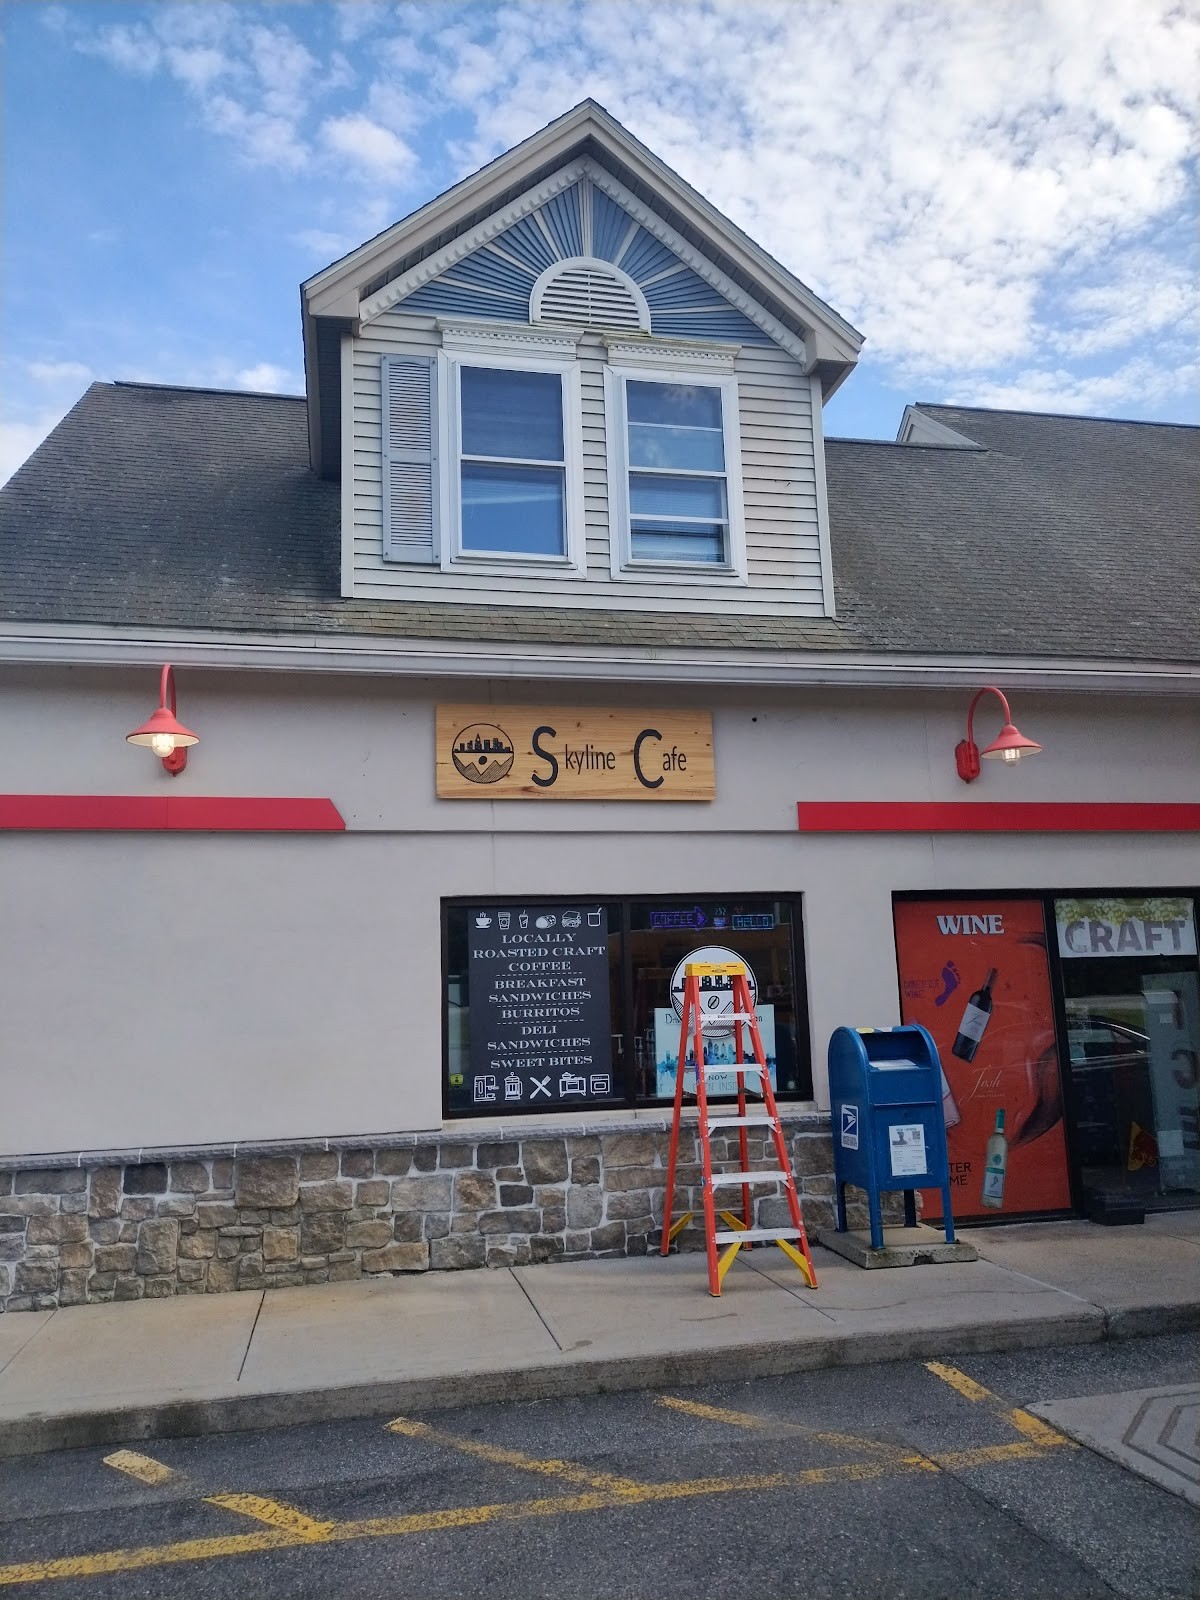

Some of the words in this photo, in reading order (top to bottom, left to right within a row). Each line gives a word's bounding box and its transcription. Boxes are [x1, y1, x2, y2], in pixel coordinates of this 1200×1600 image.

[531, 725, 616, 787] Skyline
[633, 728, 688, 789] Cafe
[653, 913, 693, 925] COFFEE
[737, 916, 769, 928] HELLO
[936, 914, 1005, 935] WINE
[502, 933, 576, 944] LOCALLY
[1064, 919, 1186, 953] CRAFT
[472, 947, 549, 959] ROASTED
[552, 945, 606, 957] CRAFT
[508, 961, 571, 972] COFFEE
[494, 977, 586, 990] BREAKFAST
[488, 990, 592, 1003] SANDWICHES
[501, 1007, 580, 1019] BURRITOS
[521, 1025, 557, 1036] DELI
[487, 1037, 591, 1051] SANDWICHES
[490, 1057, 546, 1069] SWEET
[549, 1055, 593, 1067] BITES
